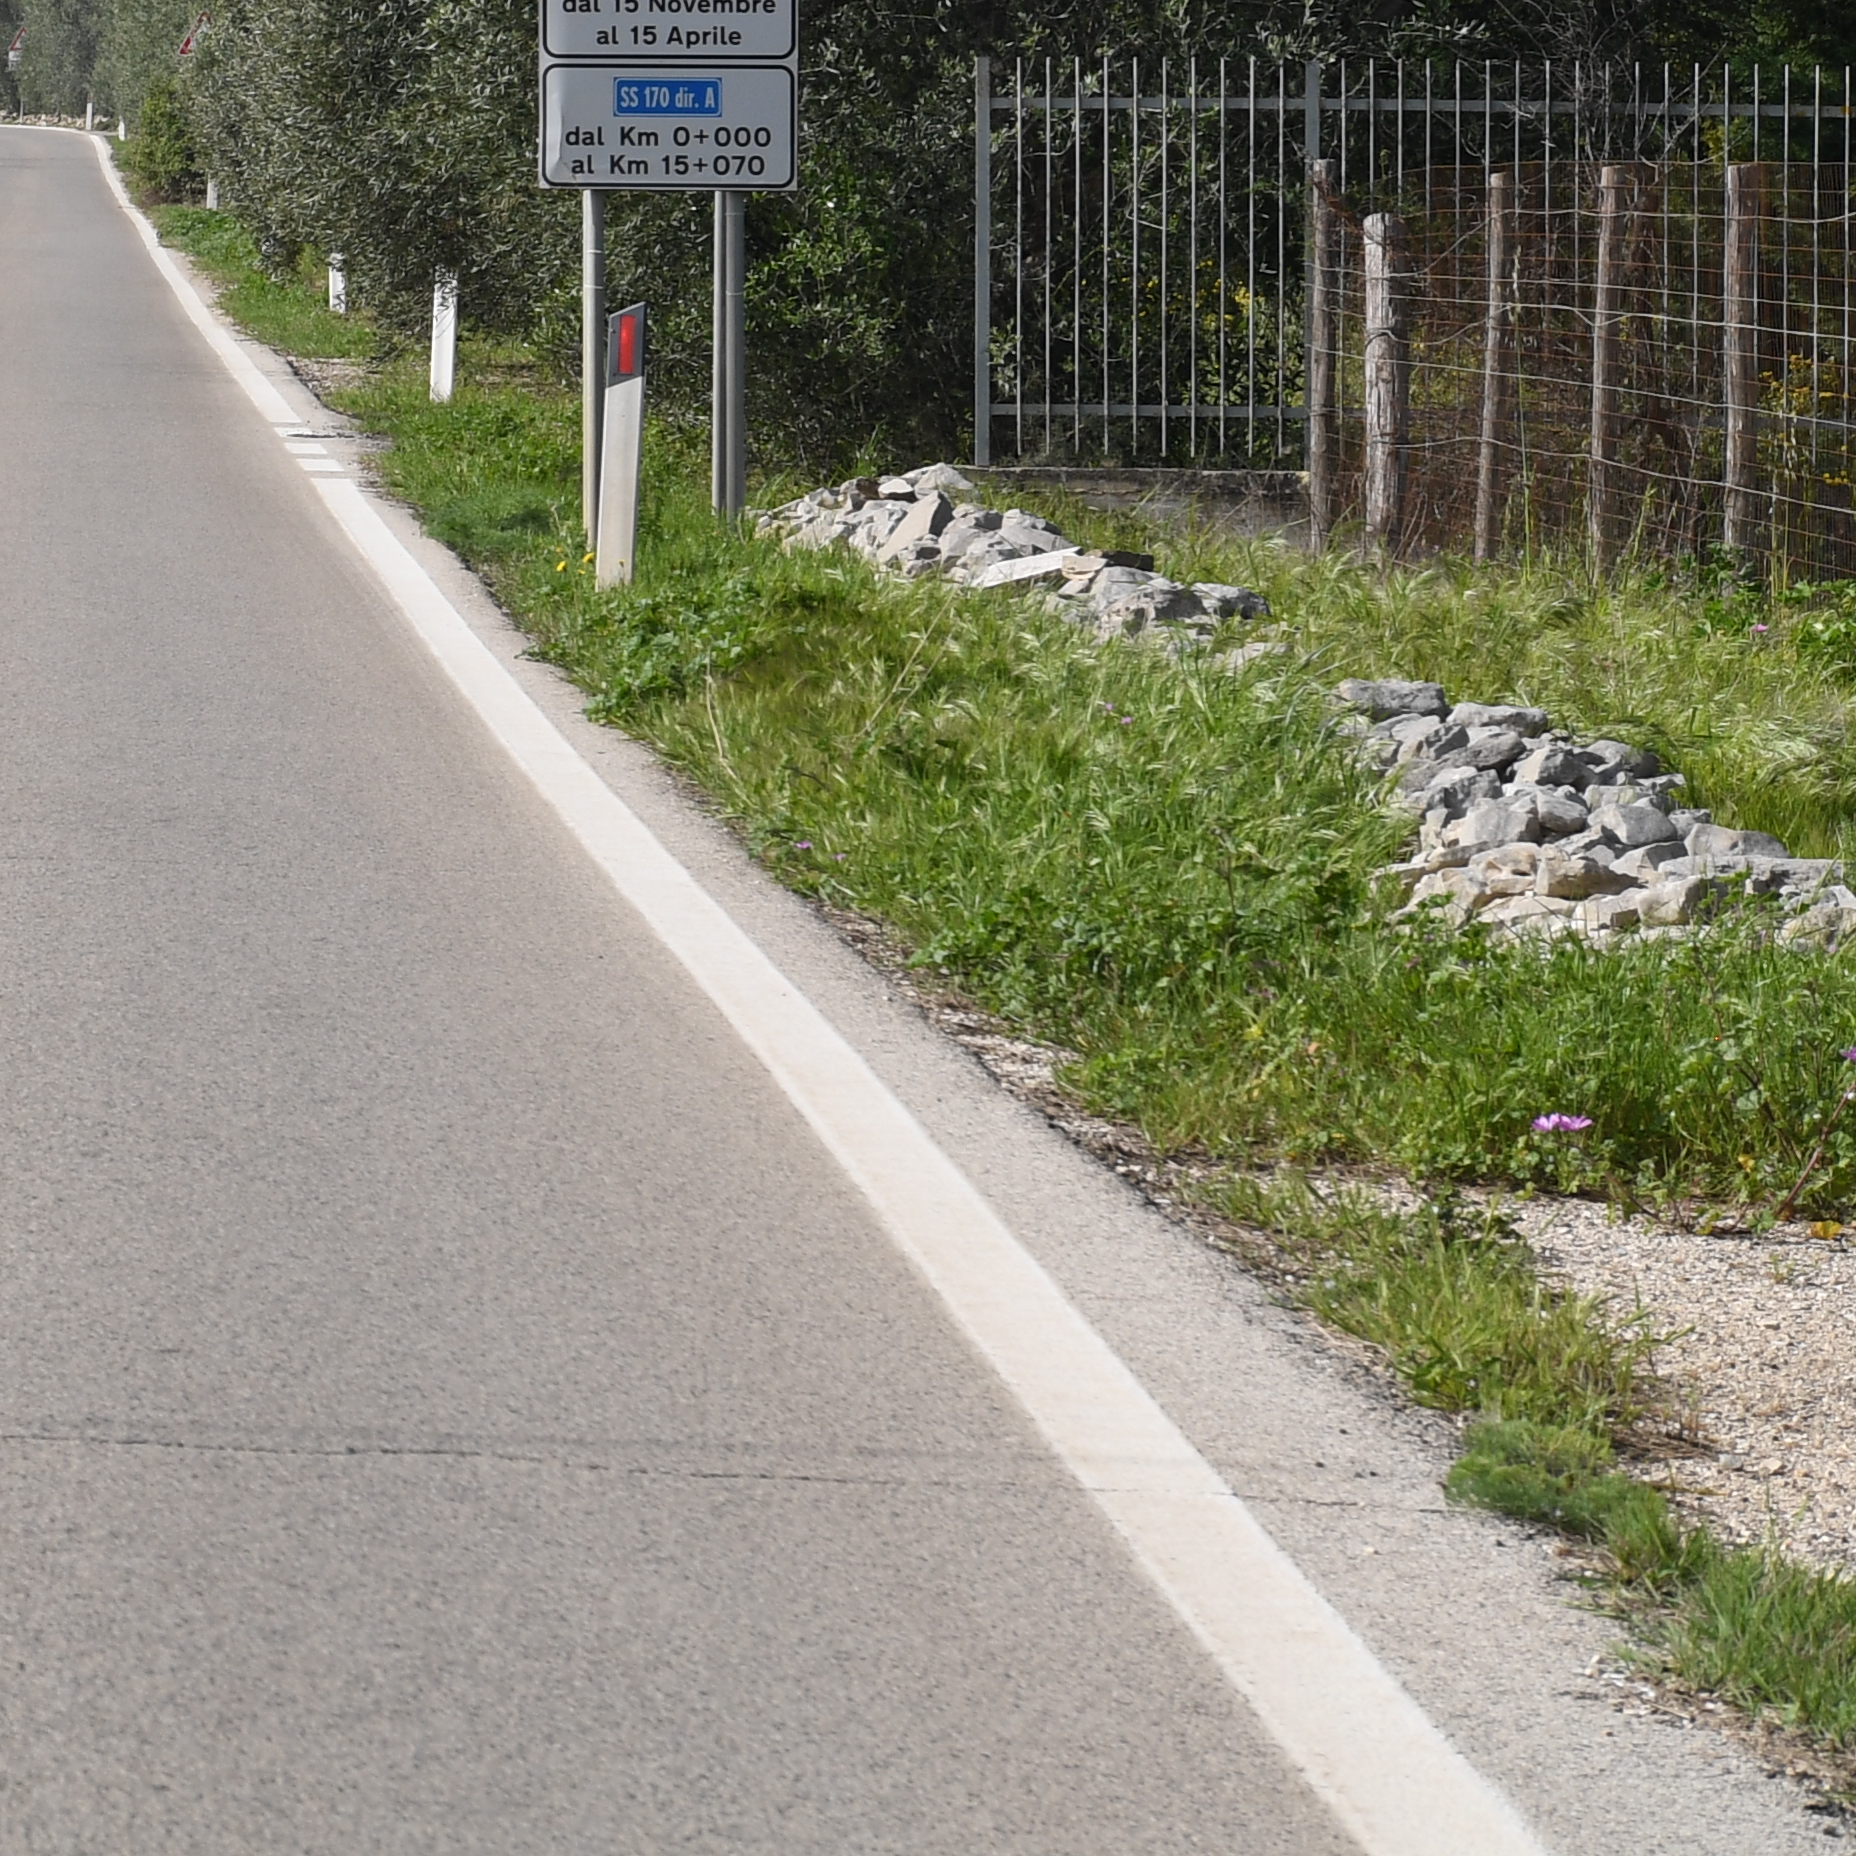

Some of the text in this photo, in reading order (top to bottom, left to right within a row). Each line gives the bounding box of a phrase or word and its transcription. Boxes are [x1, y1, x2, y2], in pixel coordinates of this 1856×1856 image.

[596, 25, 742, 50] al 15 Aprile
[620, 86, 715, 108] SS 170 dir. A
[565, 125, 772, 148] dal Km 0+000
[571, 154, 765, 176] al Km 15+070
